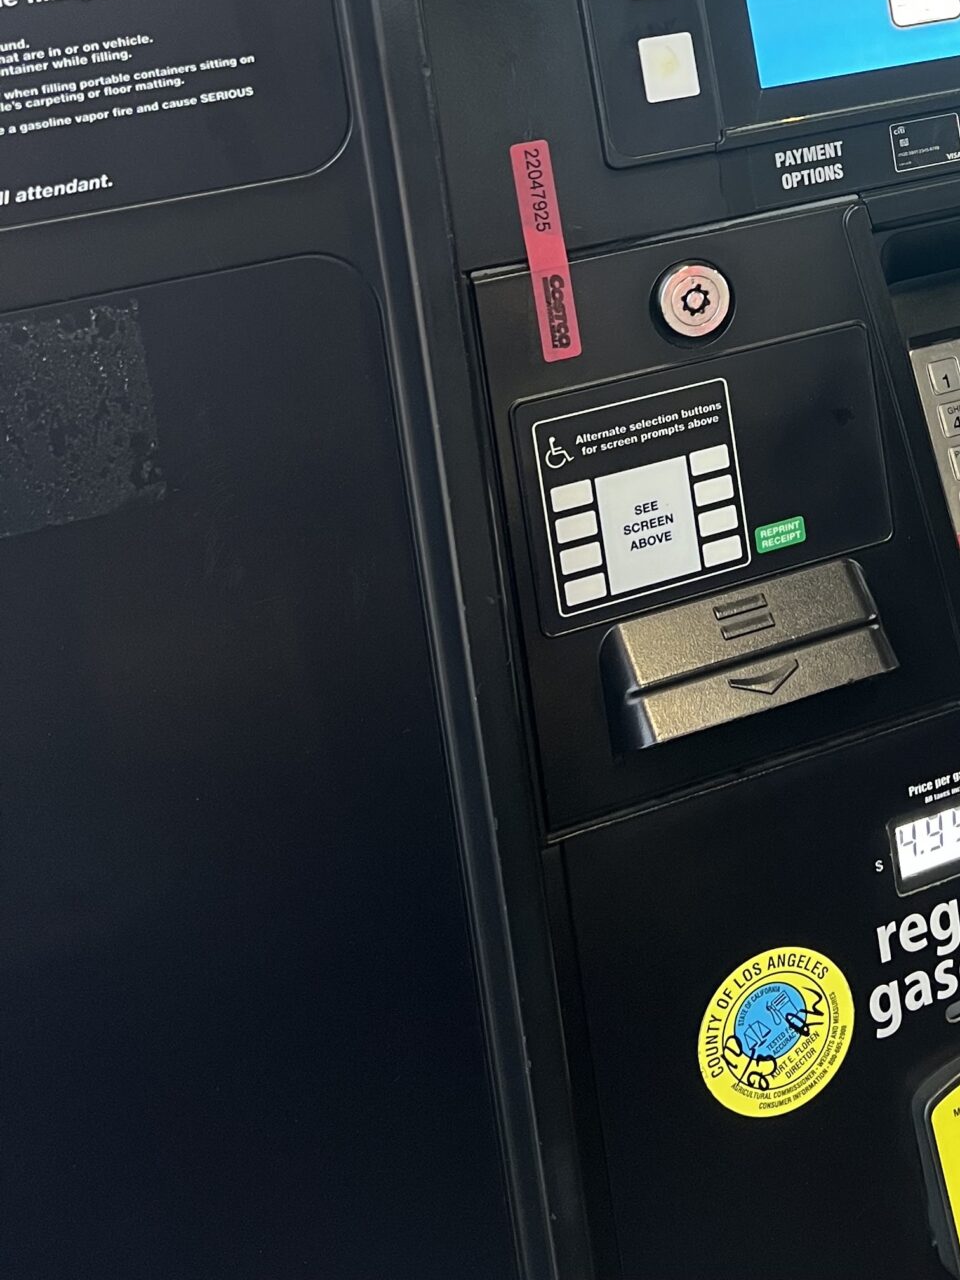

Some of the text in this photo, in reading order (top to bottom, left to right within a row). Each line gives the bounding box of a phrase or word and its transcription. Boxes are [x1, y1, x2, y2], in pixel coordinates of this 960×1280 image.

[200, 86, 254, 104] SERIOUS
[775, 141, 843, 168] PAYMENT
[782, 162, 844, 190] OPTIONS
[15, 174, 112, 204] attendant.
[524, 148, 551, 232] 22047925
[576, 403, 722, 444] Alternate selection buttons
[582, 414, 719, 456] for screen prompts above
[634, 501, 658, 516] SEE
[623, 512, 674, 536] SCREEN
[760, 520, 800, 540] REPRINT
[630, 531, 672, 551] ABOVE
[762, 530, 801, 549] RECEIPT
[909, 781, 932, 797] Price
[935, 774, 950, 789] per
[706, 954, 829, 1078] COUNTY OF LOS ANGELES
